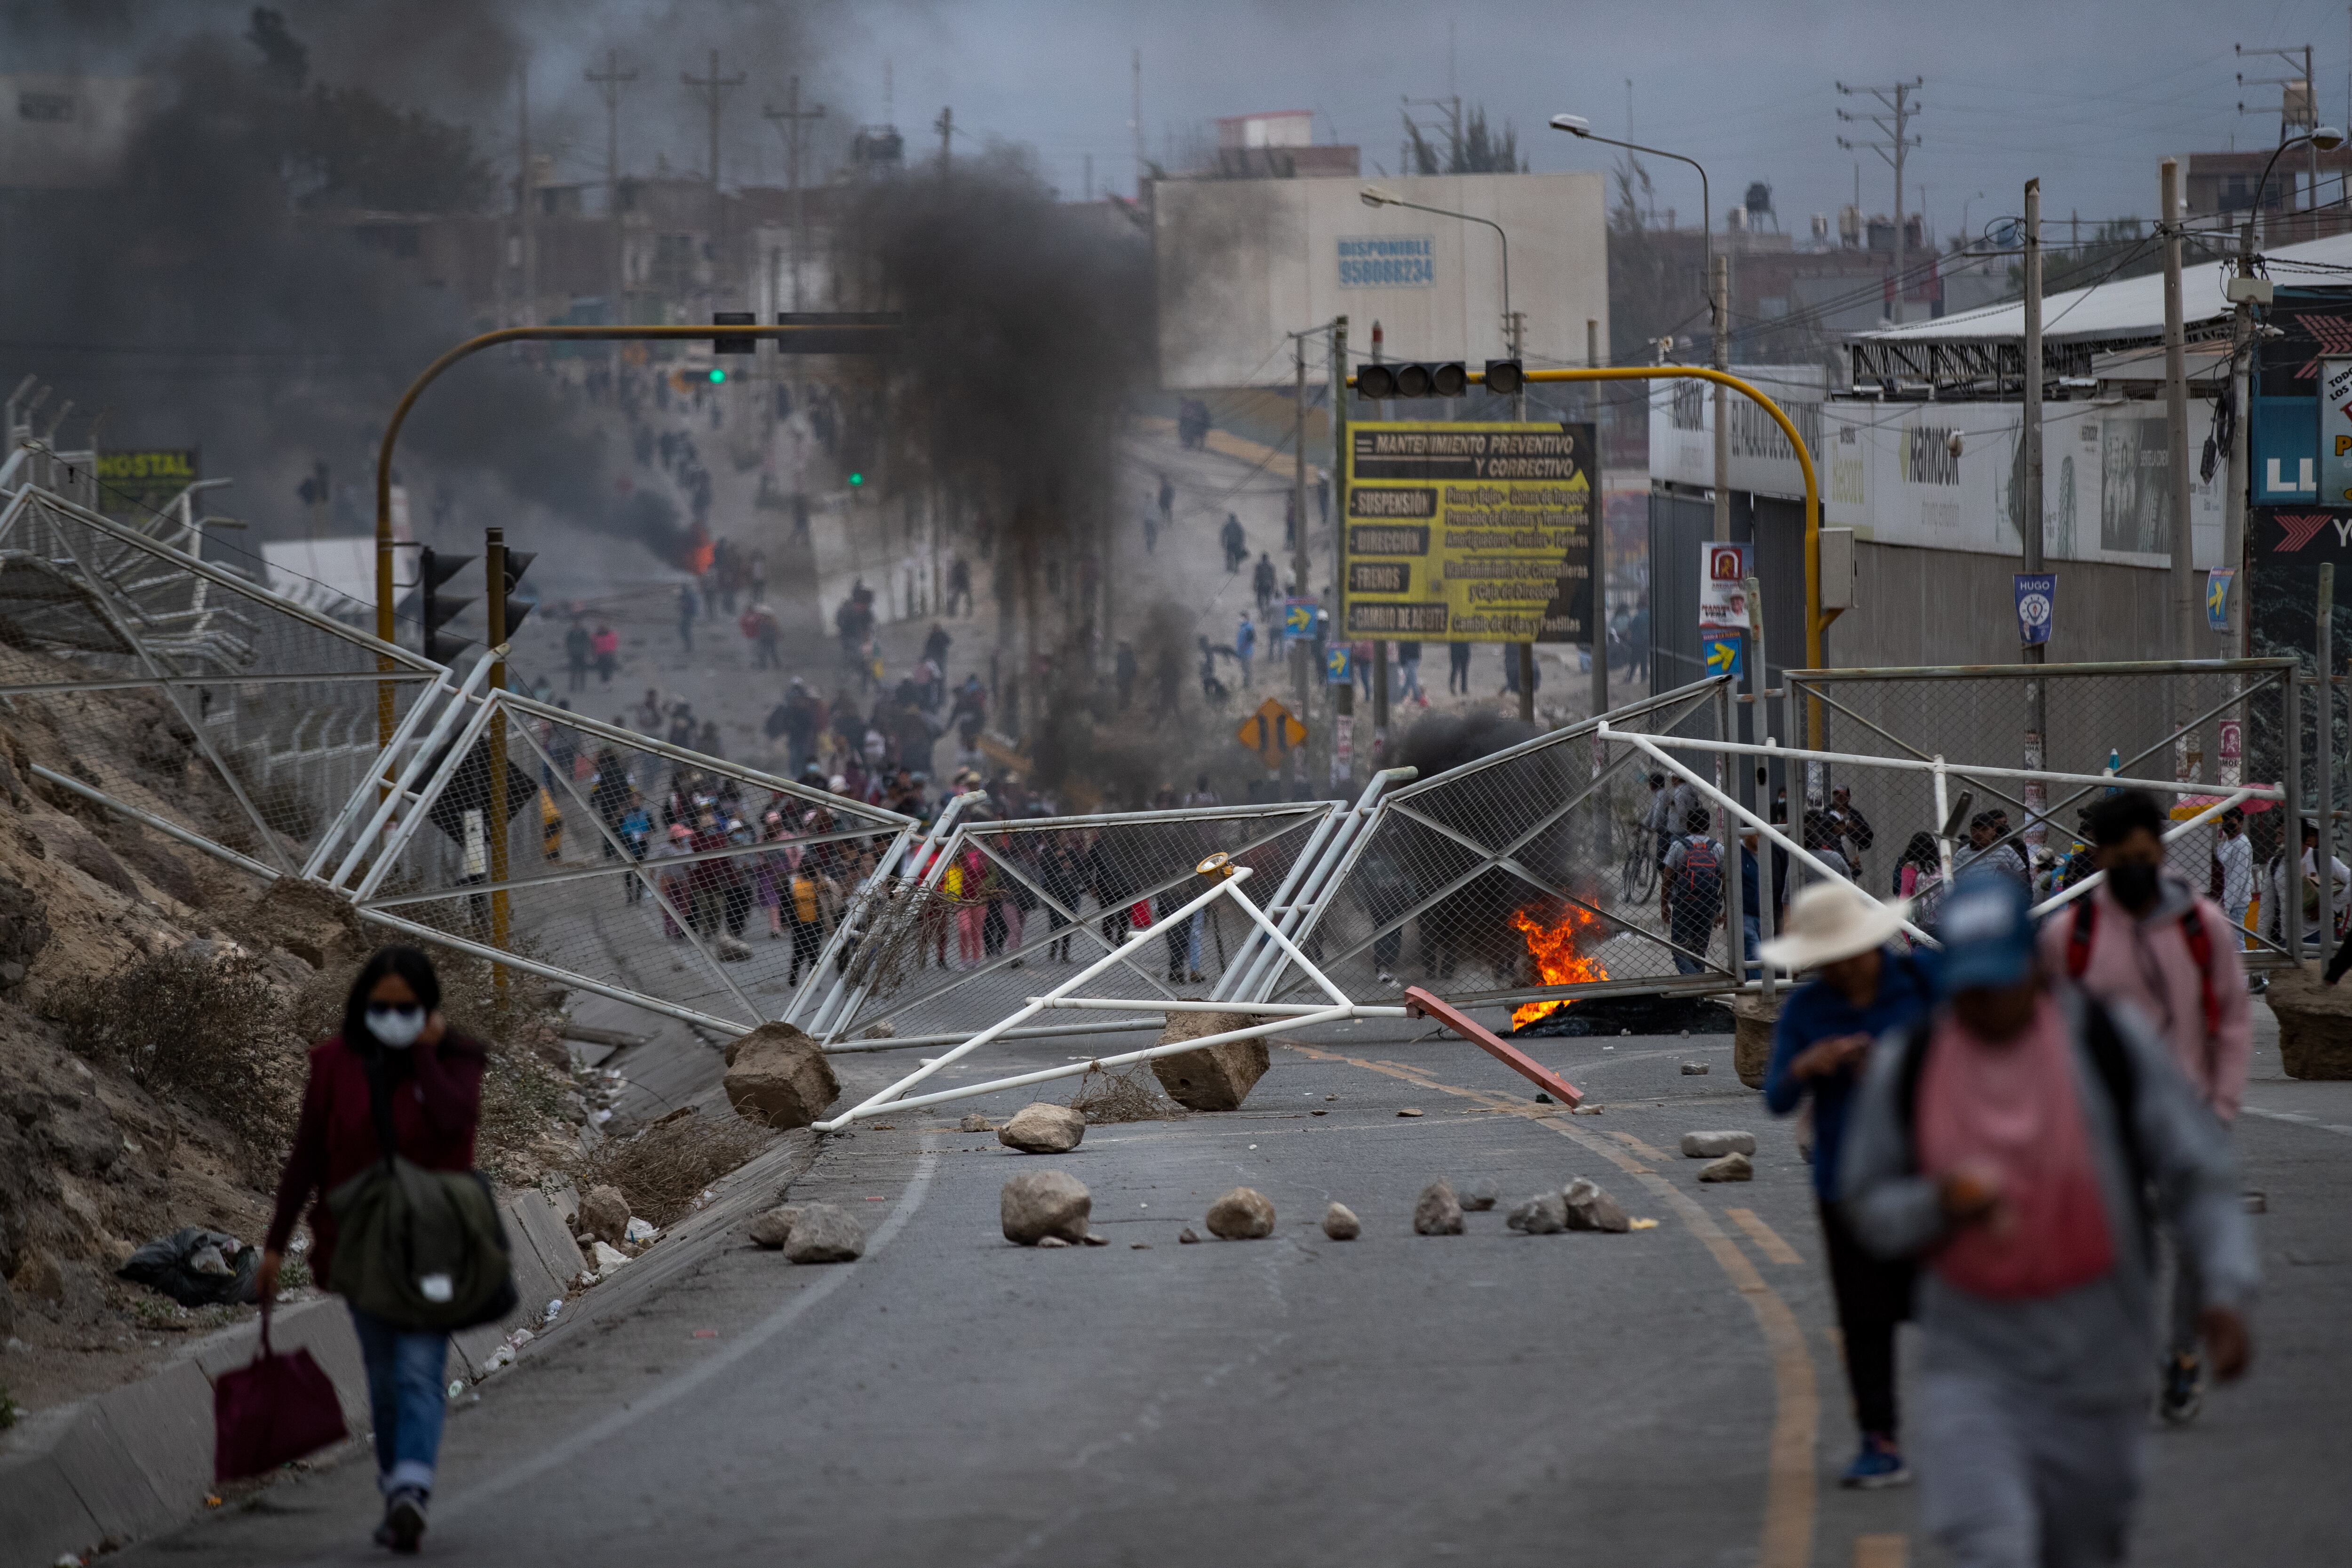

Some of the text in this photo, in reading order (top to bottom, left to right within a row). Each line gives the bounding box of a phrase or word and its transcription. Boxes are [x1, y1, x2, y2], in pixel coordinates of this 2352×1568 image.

[2329, 385, 2349, 401] LOS
[1376, 434, 1574, 454] MANTENIMIENTO PREVENTIVO
[1474, 457, 1574, 478] Y CORRECTIVO
[1542, 509, 1589, 527] Terminales
[1357, 566, 1400, 589] FRENOS
[1531, 561, 1589, 579] Cremalleras
[2020, 581, 2050, 591] HUGO
